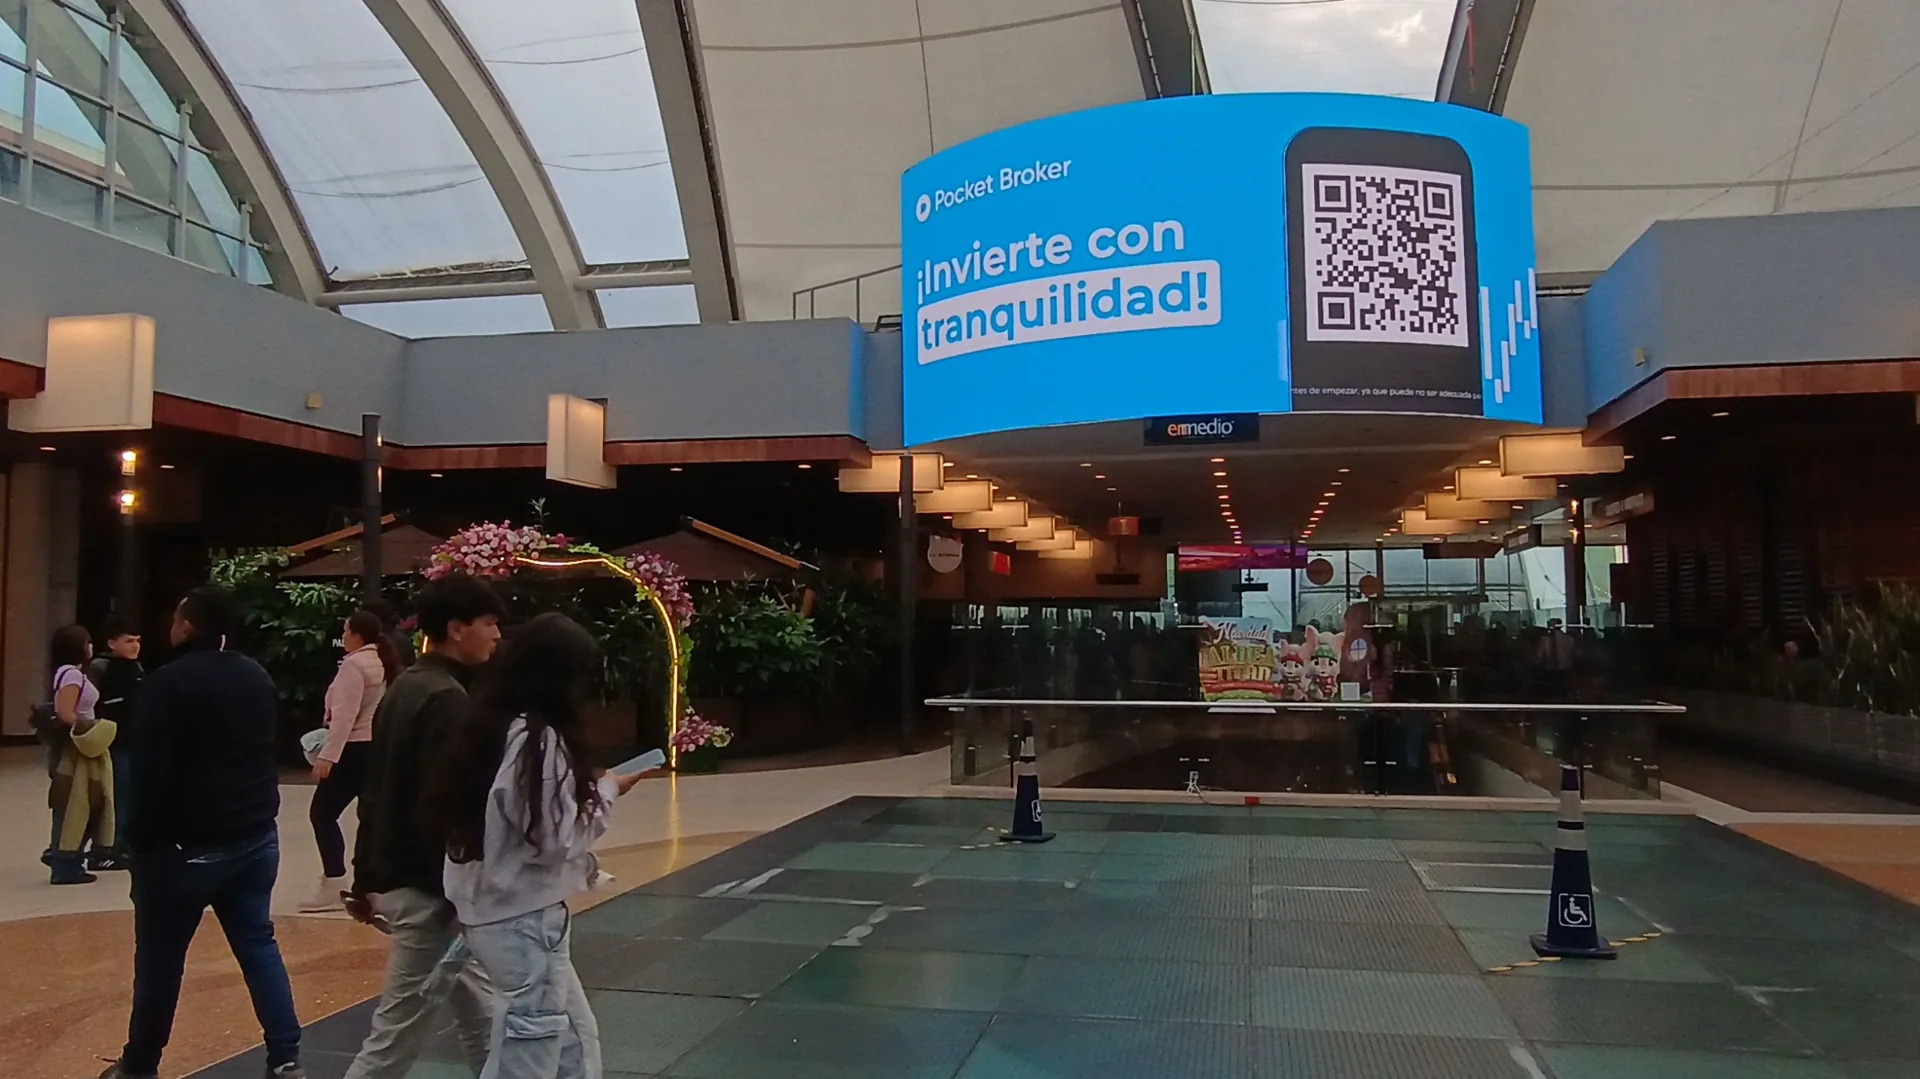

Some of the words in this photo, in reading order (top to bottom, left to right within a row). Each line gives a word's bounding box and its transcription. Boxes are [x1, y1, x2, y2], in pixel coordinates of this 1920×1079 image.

[935, 175, 994, 211] Pocket
[1000, 160, 1072, 191] Broker
[917, 232, 1072, 305] ¡Invierte
[1088, 219, 1184, 258] con
[921, 270, 1208, 351] tranquilidad!
[1309, 387, 1320, 395] de
[1372, 388, 1388, 397] que
[1213, 622, 1269, 644] Navidad
